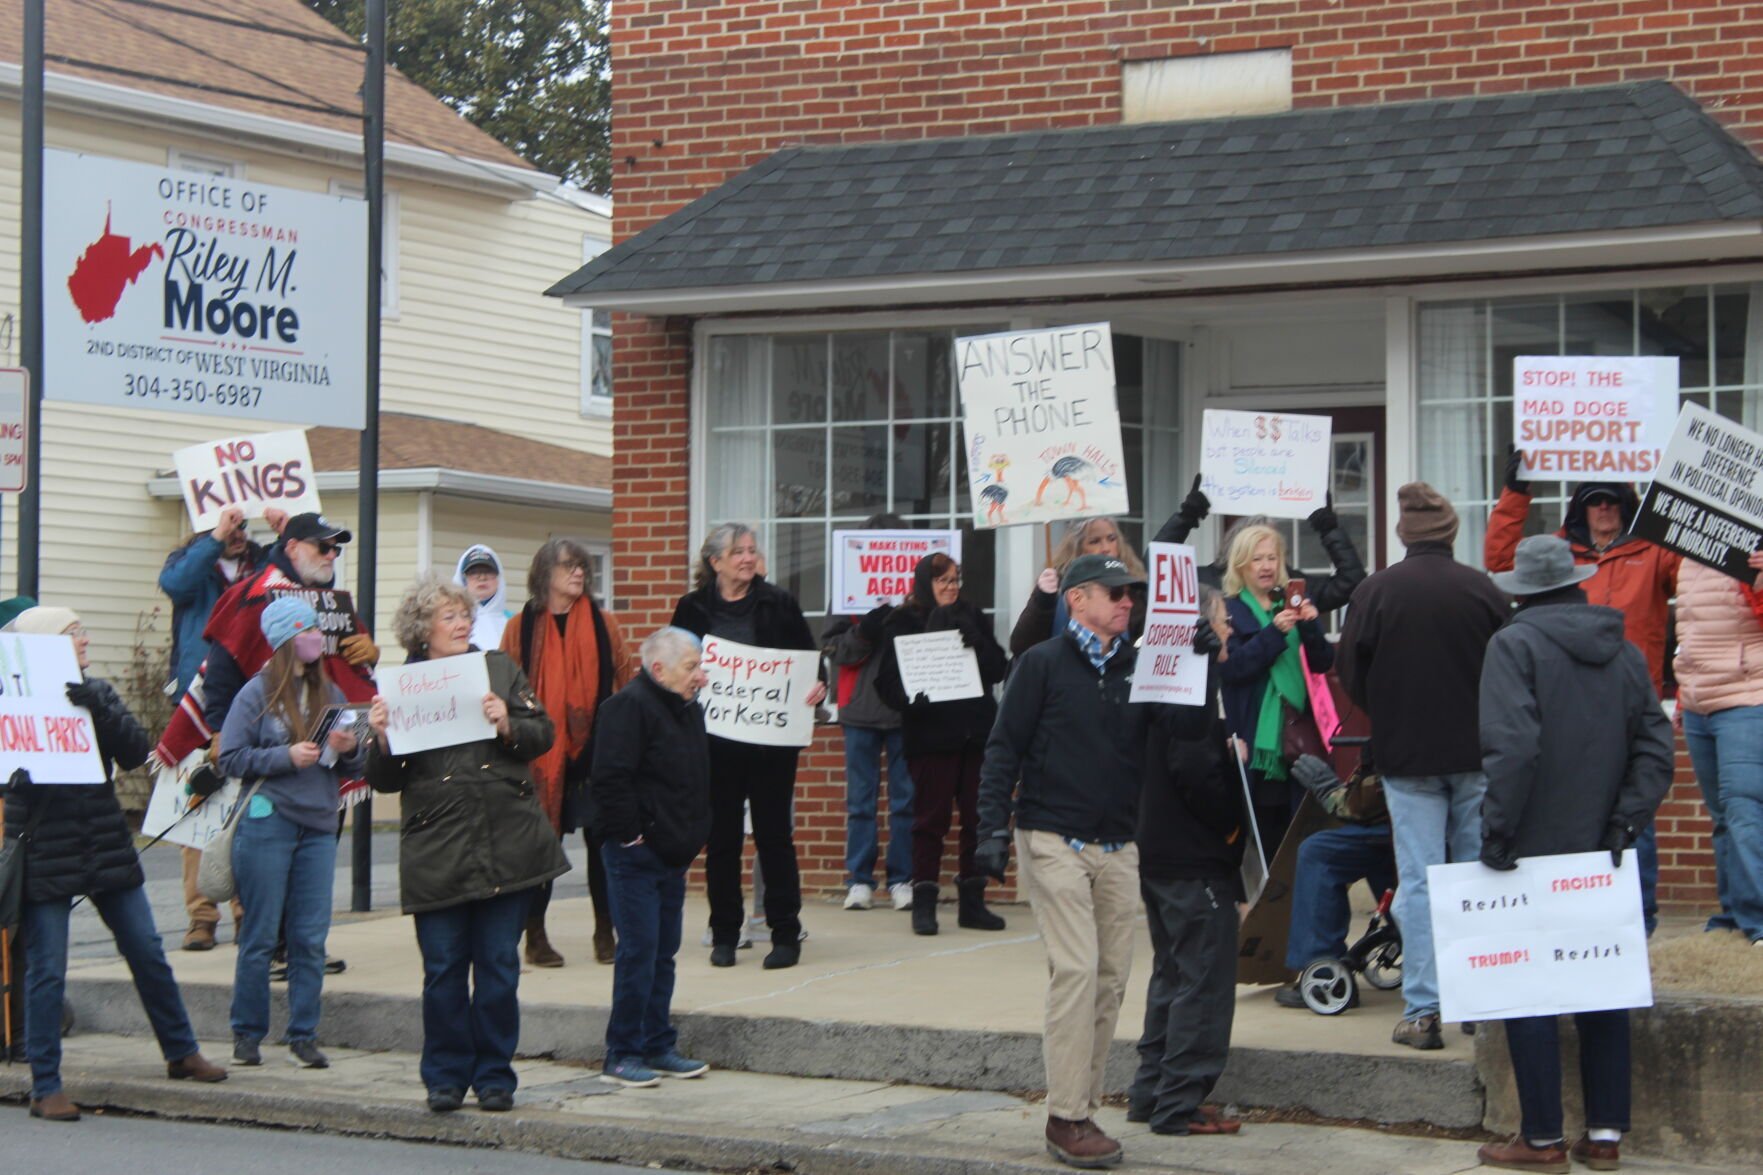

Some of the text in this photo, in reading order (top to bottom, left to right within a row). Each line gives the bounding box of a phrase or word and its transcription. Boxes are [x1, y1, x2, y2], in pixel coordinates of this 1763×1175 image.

[158, 178, 268, 214] OFFICE OF
[164, 210, 298, 243] CONGRESSMAN
[165, 227, 297, 301] Riley M.
[164, 280, 300, 343] Moore
[87, 340, 331, 386] 2ND DISTRICT OF WEST VIRGINIA
[960, 329, 1110, 382] ANSWER
[124, 374, 262, 408] 304-350-6987
[1012, 378, 1056, 403] THE
[1523, 371, 1624, 387] STOP! THE
[994, 399, 1093, 437] PHONE
[1522, 400, 1629, 416] MAD DOGE
[1520, 420, 1641, 442] SUPPORT
[1686, 417, 1704, 442] WE
[1702, 423, 1721, 447] NO
[1717, 430, 1755, 464] LONGER
[214, 440, 256, 467] NO
[1521, 449, 1662, 472] VETERANS!
[1669, 460, 1686, 481] IN
[1682, 465, 1731, 506] POLITICAL
[1700, 449, 1757, 490] DIFFERENCE
[190, 460, 306, 516] KINGS
[1651, 490, 1761, 554] WE HAVE A DIFFERENCE
[1663, 522, 1681, 545] IN
[868, 540, 928, 551] MAKE LYING
[859, 554, 922, 573] WRON
[1155, 553, 1197, 604] END
[321, 590, 338, 610] IS
[317, 612, 354, 633] BOVE
[1146, 624, 1198, 647] CORPORAT
[705, 642, 793, 681] Support
[1152, 654, 1181, 676] RULE
[398, 666, 461, 695] Protect
[709, 678, 791, 704] ederal
[391, 695, 457, 732] Medicaid
[704, 698, 789, 728] orkers
[0, 715, 91, 753] IONAL PARKS
[1551, 873, 1613, 893] FACISTS
[1461, 894, 1529, 913] Resist
[1468, 949, 1530, 969] TRUMP!
[1554, 944, 1621, 962] Resist
